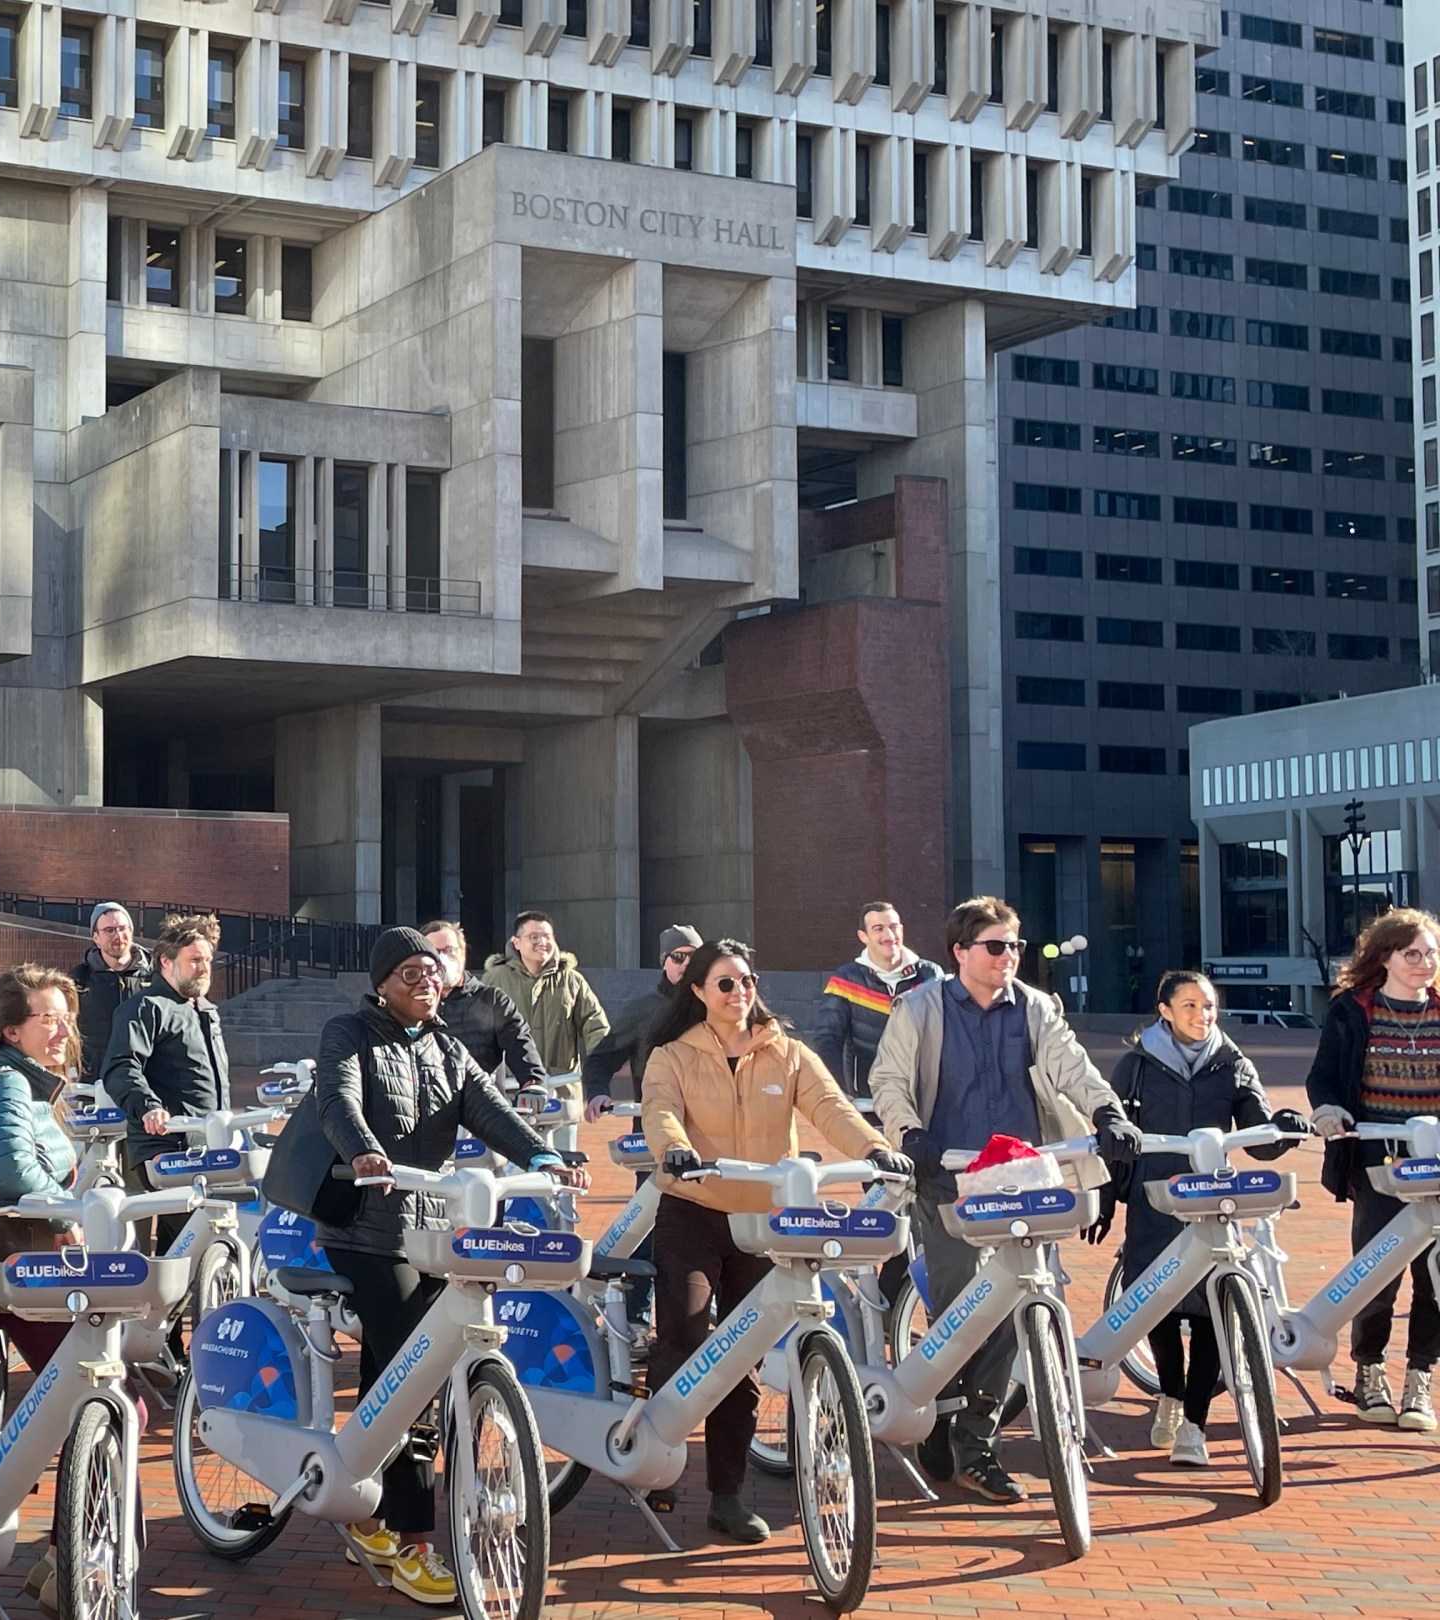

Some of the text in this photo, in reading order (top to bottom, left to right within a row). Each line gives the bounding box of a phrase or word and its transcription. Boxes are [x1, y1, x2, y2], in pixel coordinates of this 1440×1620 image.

[511, 190, 785, 250] BOSTON CITY HALL
[160, 1160, 203, 1170] BLUEbikes
[1177, 1181, 1232, 1193] BLUEbikes
[965, 1201, 1024, 1214] BLUEbikes
[779, 1217, 842, 1229] BLUEbikes
[462, 1238, 526, 1252] BLUEbikes
[16, 1265, 86, 1278] BLUEbikes
[1327, 1234, 1400, 1305] BLUEbikes
[1107, 1256, 1182, 1333] BLUEbikes
[921, 1279, 993, 1361] BLUEbikes
[201, 1342, 249, 1359] MASSACHUSETTS
[675, 1305, 761, 1398] BLUEbikes
[358, 1333, 431, 1430] BLUEbikes
